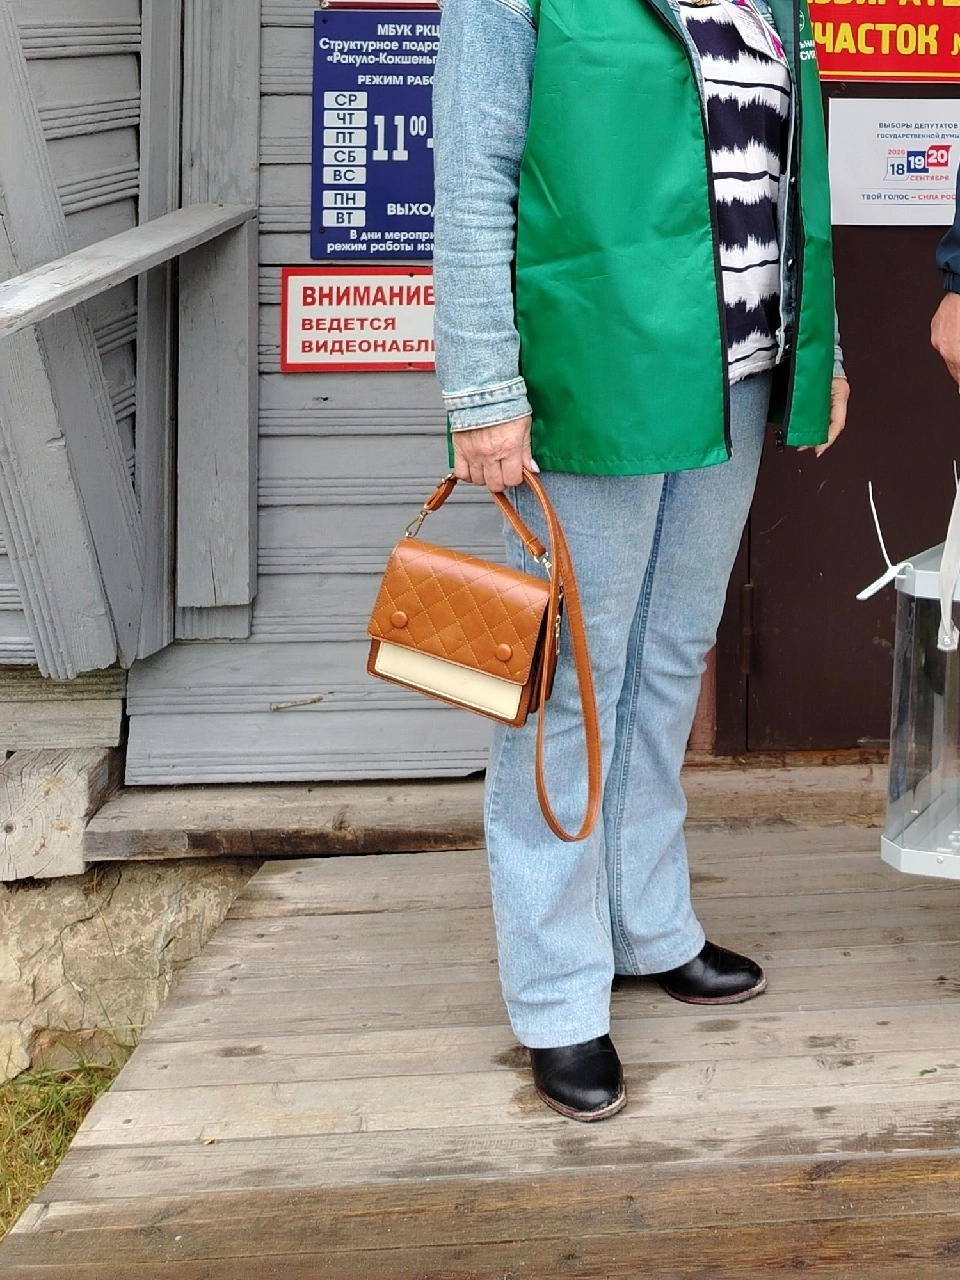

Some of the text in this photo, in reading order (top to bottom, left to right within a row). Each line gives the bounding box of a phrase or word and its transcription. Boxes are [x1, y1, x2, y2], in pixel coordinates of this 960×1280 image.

[377, 24, 413, 37] МБУК
[811, 21, 939, 56] ЧАСТОК
[319, 38, 399, 53] Структурное
[357, 75, 404, 86] РЕЖИМ
[334, 93, 358, 107] СР
[336, 113, 355, 126] ЧТ
[914, 122, 959, 130] ДЕПУТАТОВ
[335, 131, 355, 145] ПТ
[876, 132, 940, 140] ГОСУДАРСТВЕННОЙ
[333, 150, 357, 163] СБ
[889, 149, 948, 176] 18 19 20
[333, 169, 356, 182] ВС
[333, 193, 357, 206] ПН
[861, 192, 882, 200] ТВОЙ
[883, 193, 910, 201] ГОЛОС
[335, 212, 354, 225] ВТ
[350, 230, 358, 240] В
[360, 231, 382, 242] дни
[327, 243, 367, 252] режим
[370, 241, 414, 253] работы
[302, 285, 435, 307] ВНИМАНИЕ
[301, 317, 397, 333] ВЕДЕТСЯ
